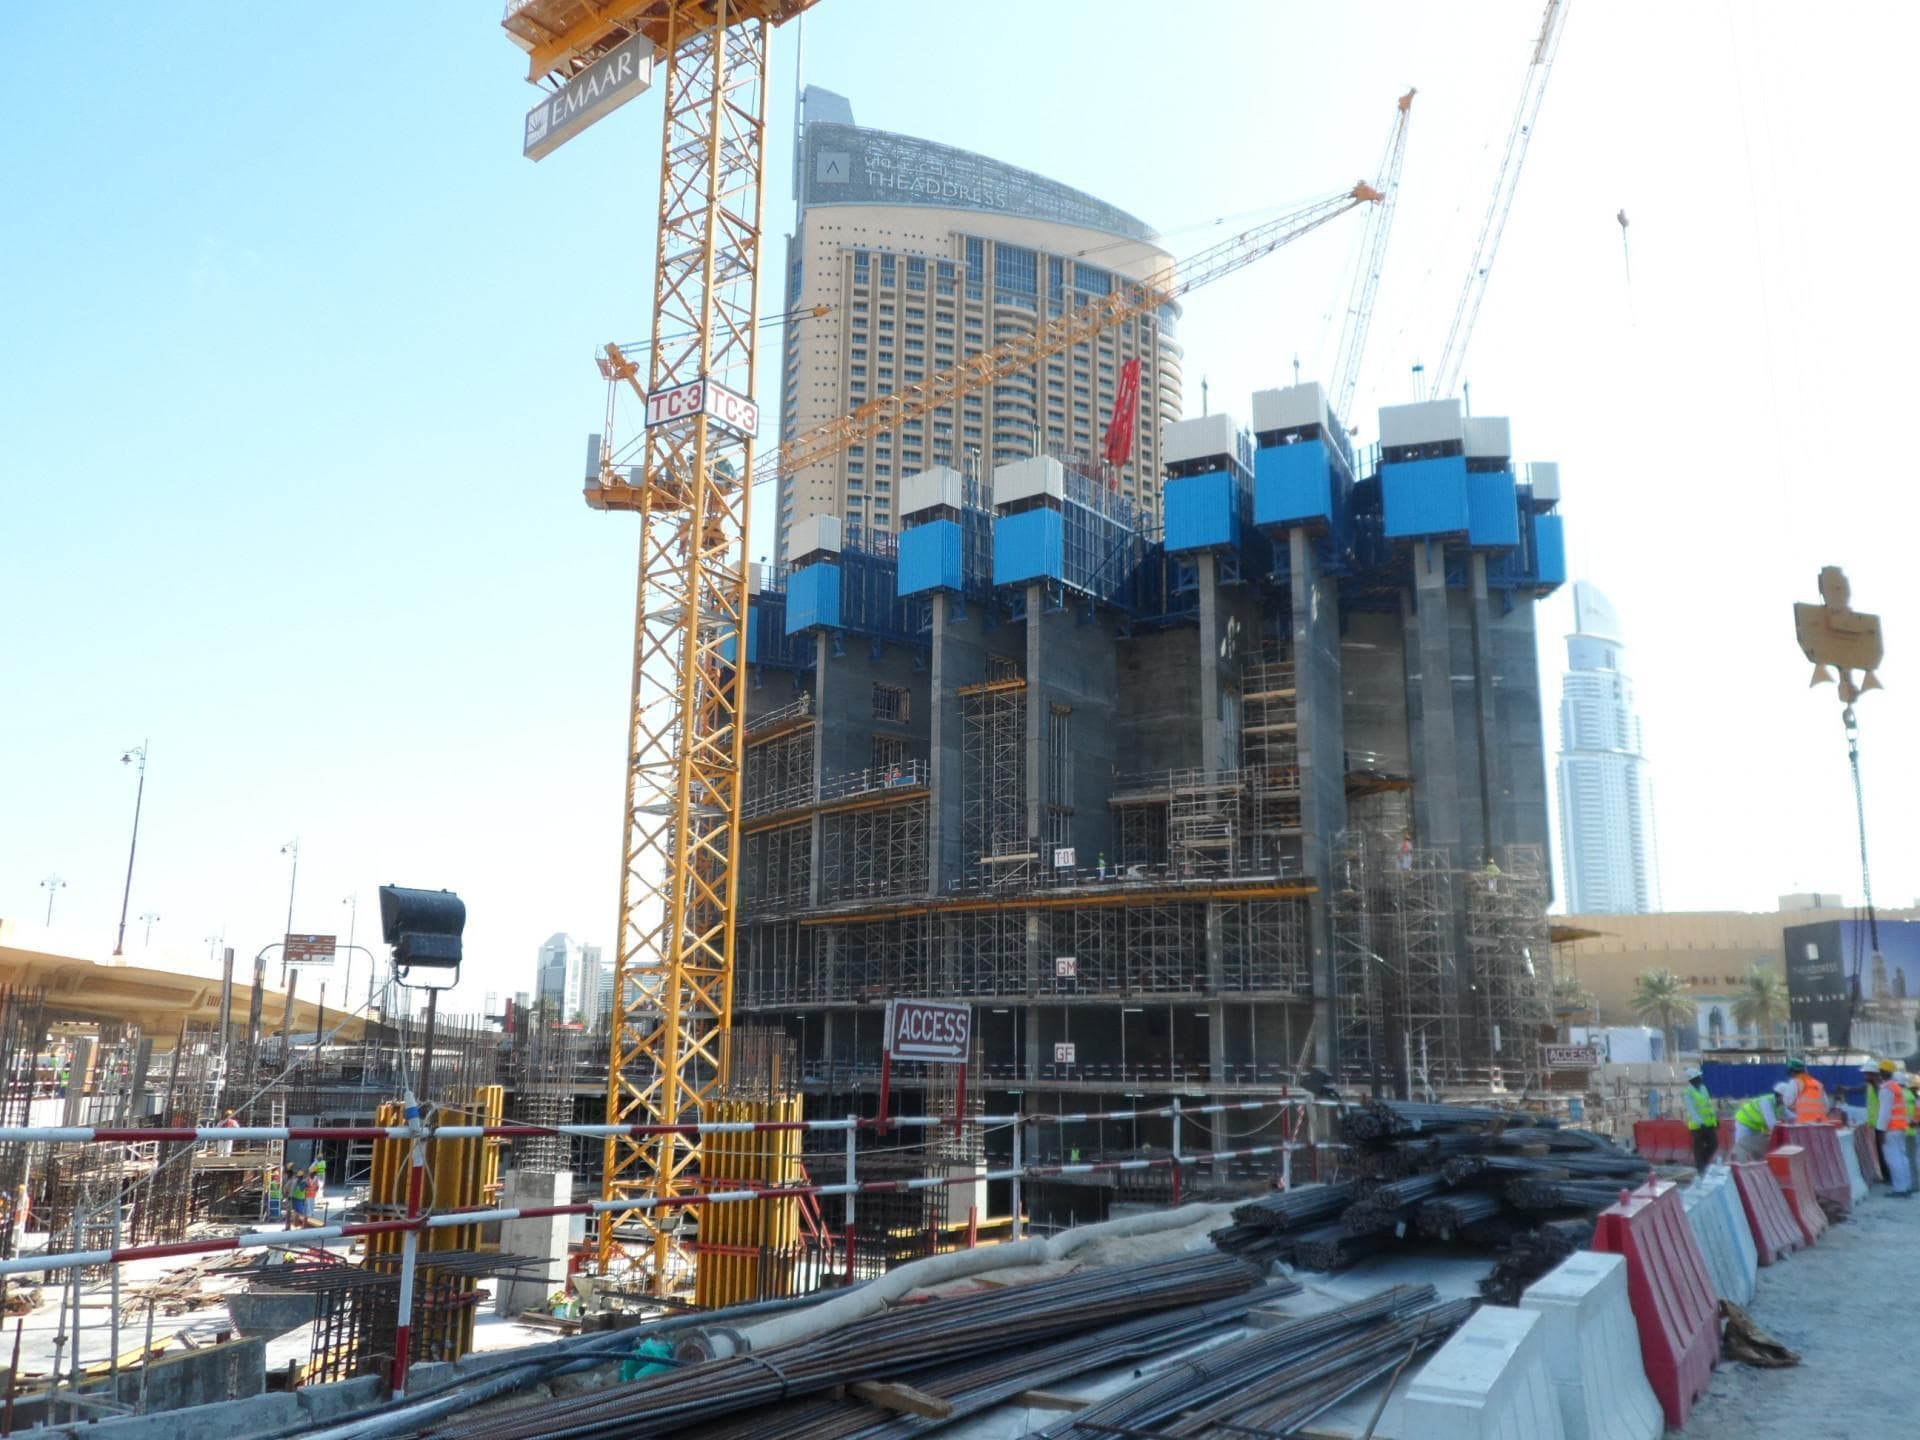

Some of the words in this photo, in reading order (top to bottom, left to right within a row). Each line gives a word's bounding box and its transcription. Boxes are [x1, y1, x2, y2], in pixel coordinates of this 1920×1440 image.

[552, 51, 633, 126] EMAAR
[650, 384, 701, 421] TC-3
[709, 384, 756, 431] TC-3
[1057, 960, 1077, 975] GM
[898, 1008, 967, 1044] ACCESS
[1056, 1046, 1073, 1062] GF
[1550, 1049, 1595, 1060] ACCESS
